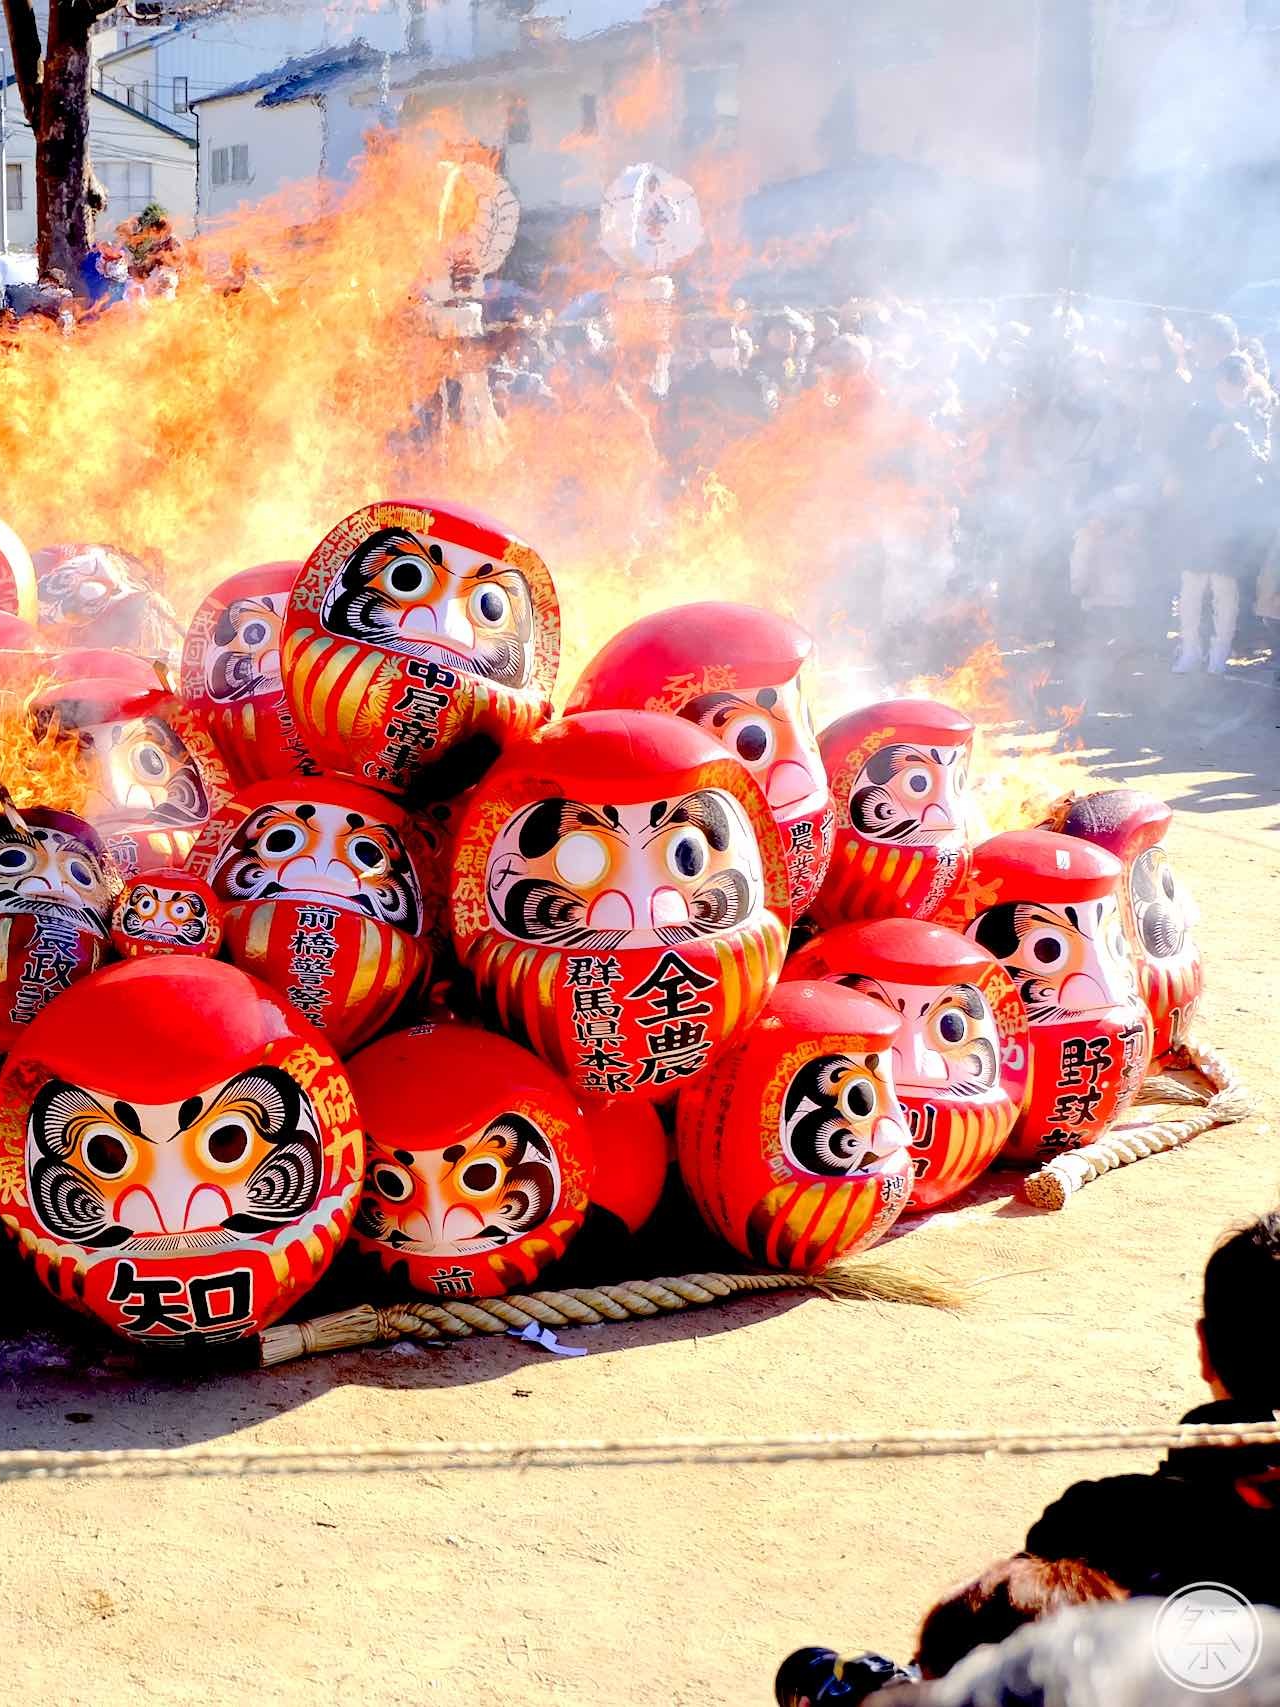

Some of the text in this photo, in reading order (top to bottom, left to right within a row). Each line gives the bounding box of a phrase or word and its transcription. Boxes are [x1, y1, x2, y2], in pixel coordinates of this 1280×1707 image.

[564, 957, 635, 1096] 群馬県本部
[624, 950, 718, 1087] 全農
